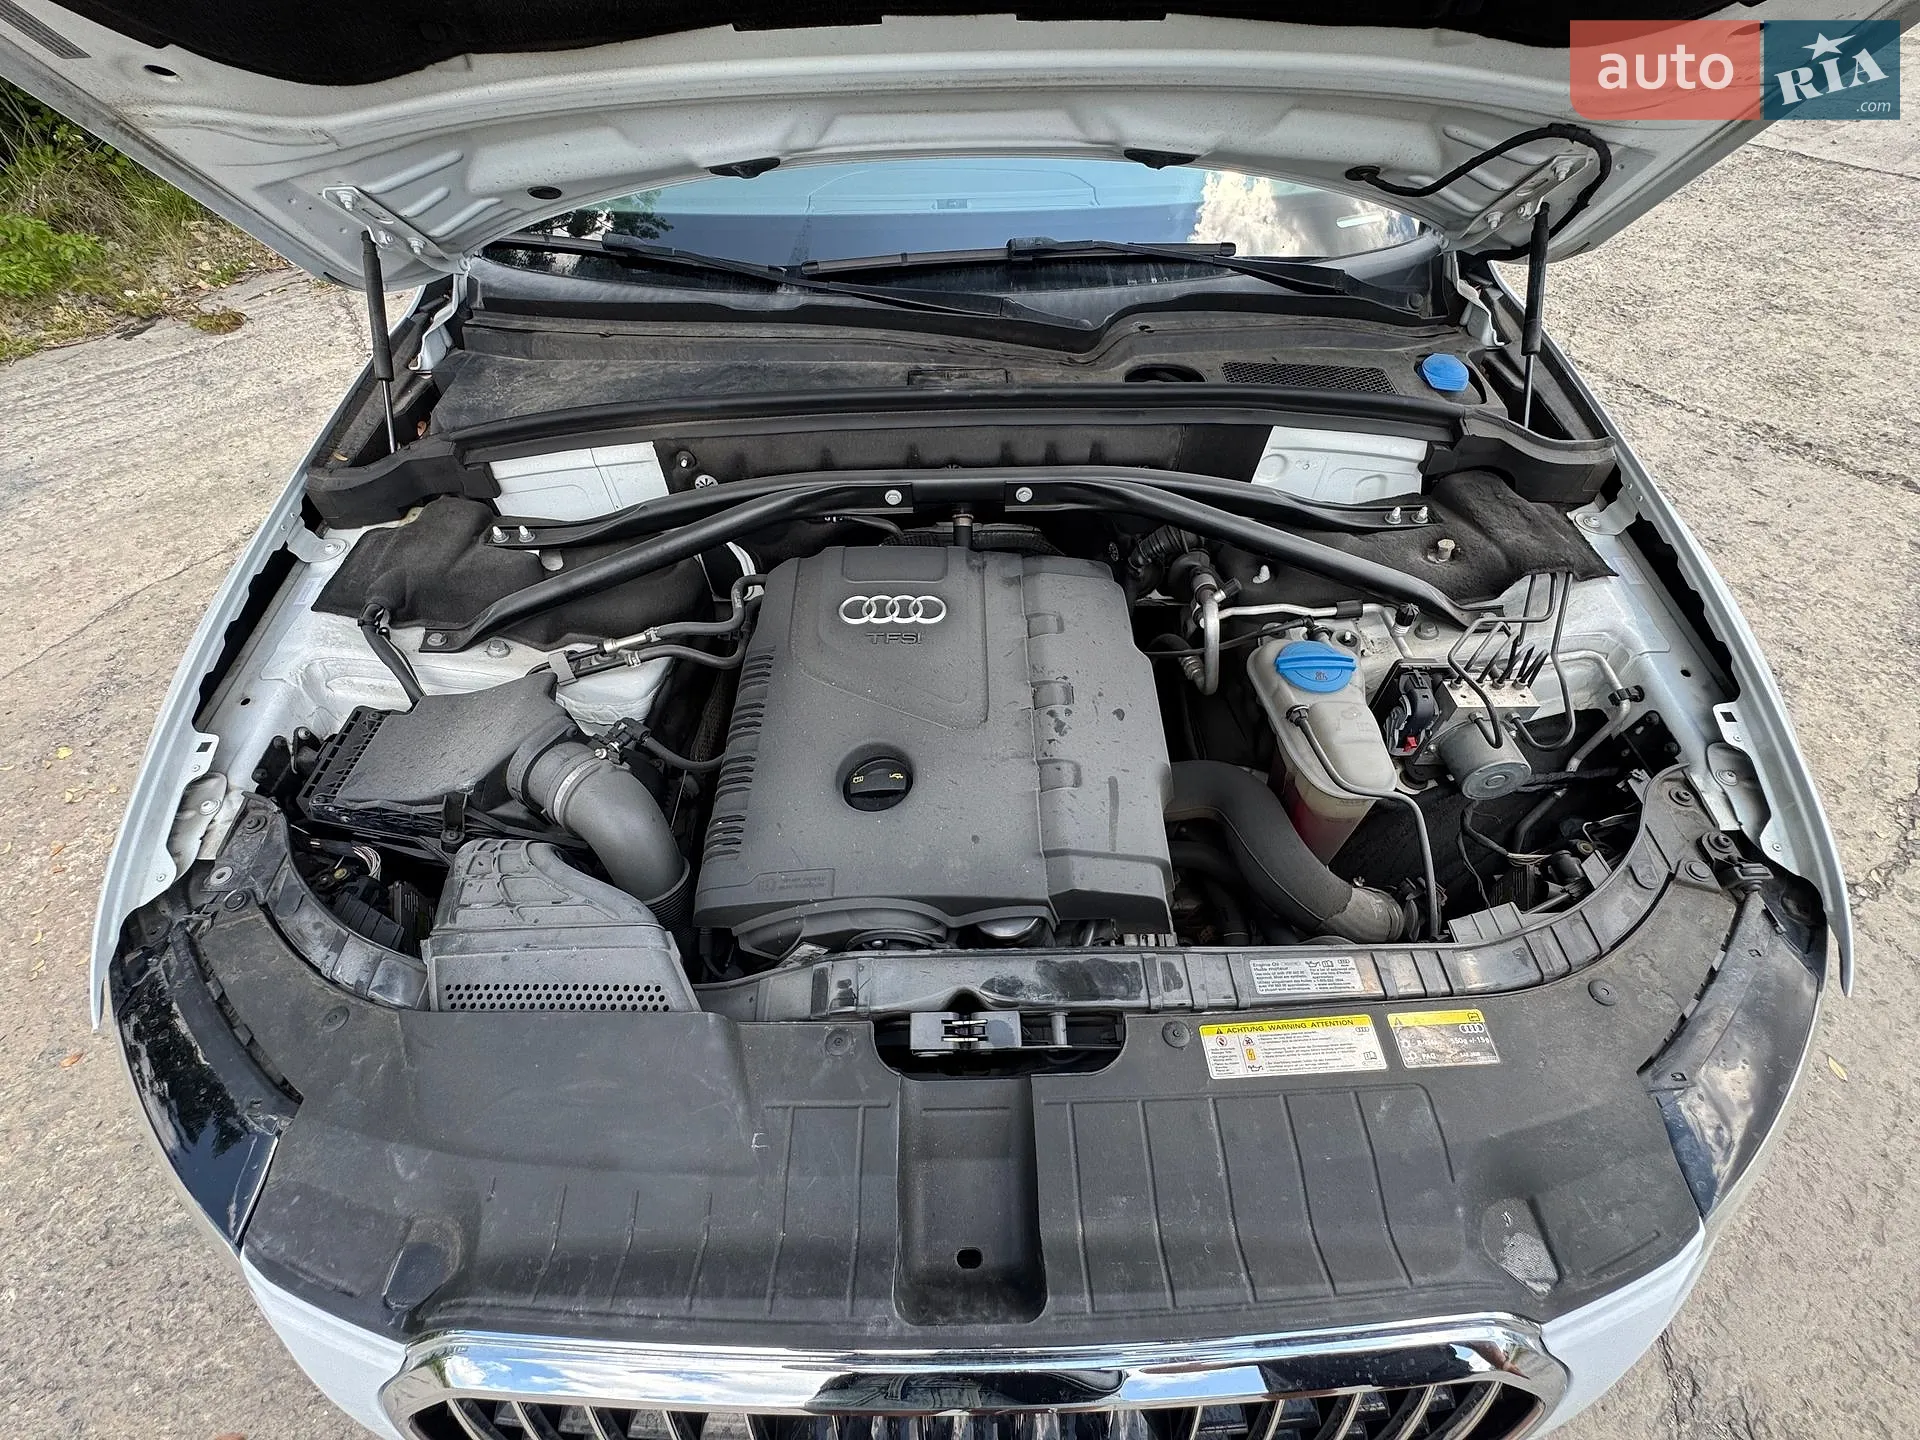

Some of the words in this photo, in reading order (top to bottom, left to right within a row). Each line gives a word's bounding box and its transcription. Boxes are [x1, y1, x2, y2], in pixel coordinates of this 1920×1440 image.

[866, 632, 921, 645] TFSI
[1226, 1025, 1265, 1034] ACHTUNG
[1267, 1022, 1307, 1031] WARNING
[1310, 1019, 1354, 1028] ATTENTION
